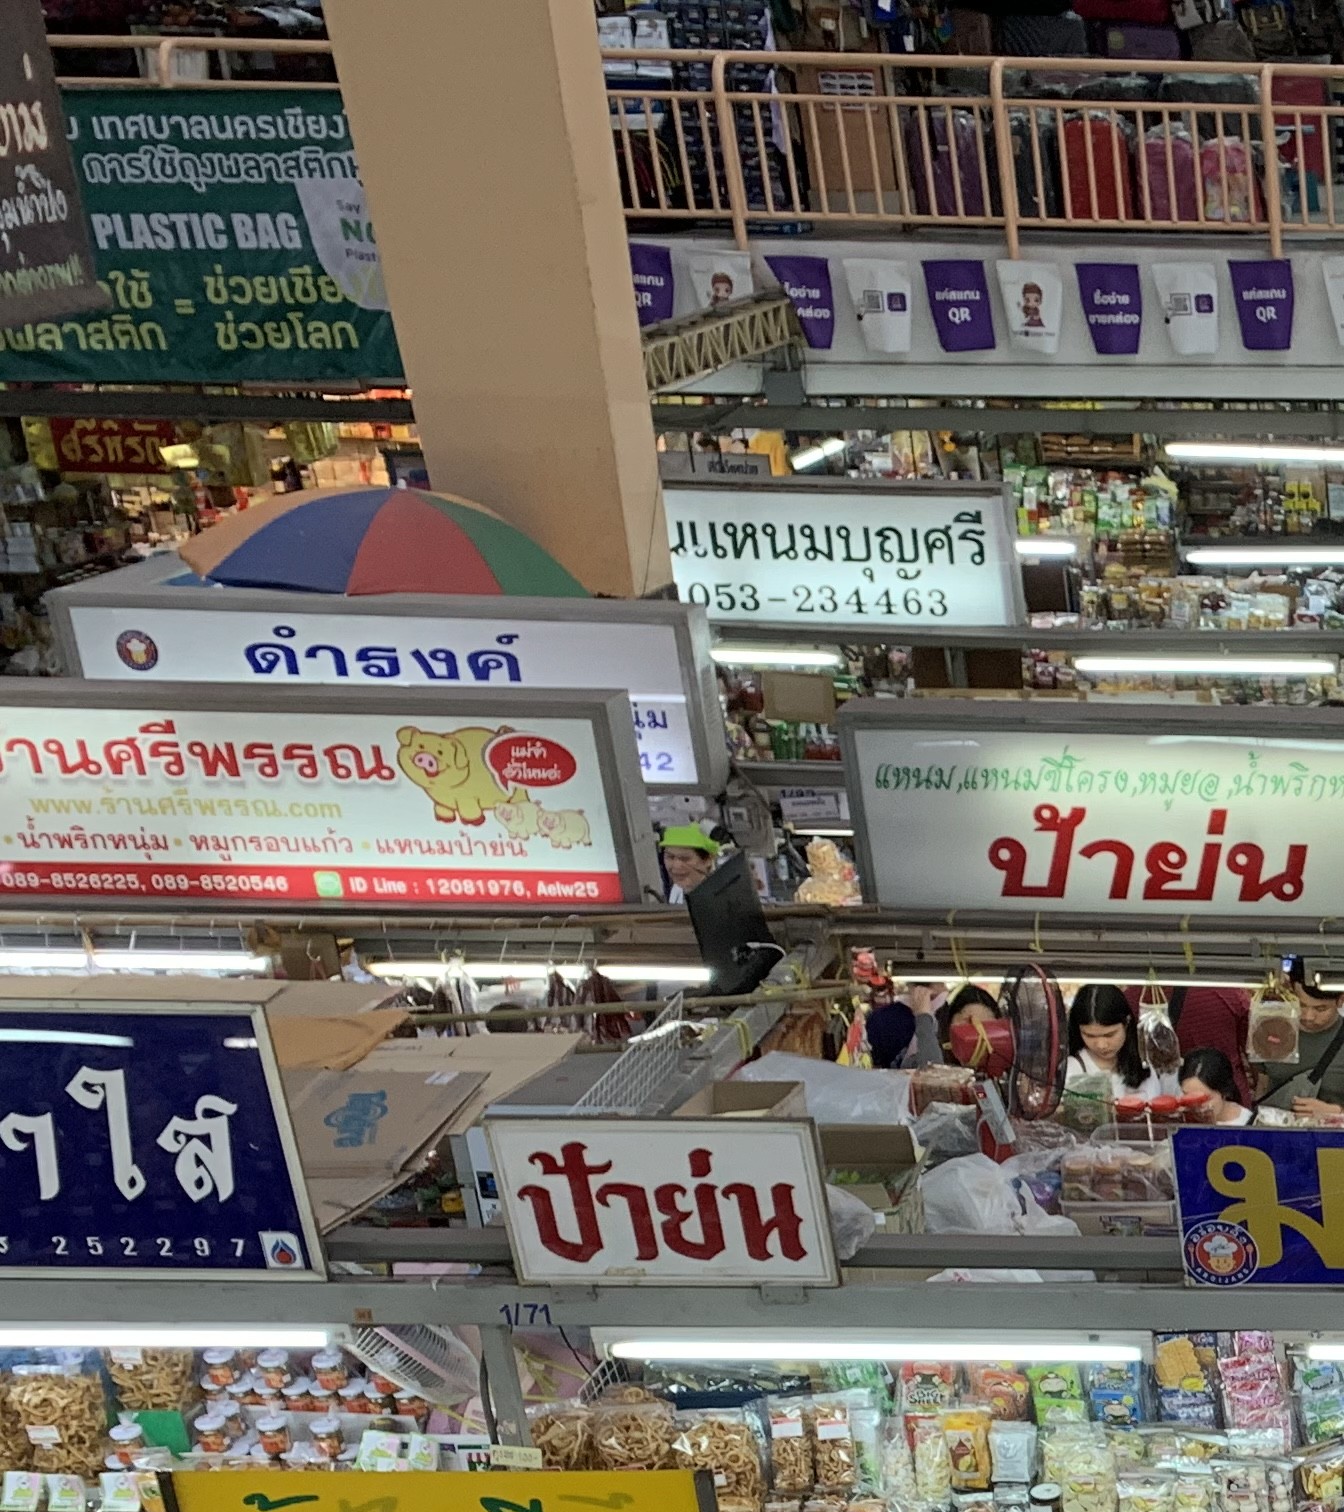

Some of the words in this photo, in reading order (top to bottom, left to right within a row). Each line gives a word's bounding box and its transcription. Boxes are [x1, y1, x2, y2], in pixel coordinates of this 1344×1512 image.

[93, 108, 348, 140] เทศบาลนครเชียง
[92, 213, 227, 250] PLASTIC
[232, 213, 301, 250] BAG
[215, 311, 359, 351] ช่วยโลก
[948, 307, 971, 324] QR
[1255, 305, 1278, 322] QR
[687, 583, 949, 618] 053-234463
[243, 626, 523, 684] ดำรงค์
[0, 719, 398, 784] านศรีพรรณ
[17, 815, 170, 861] น้ำพริกหนุ่ม
[189, 827, 355, 862] หมูกรอบแก้ว
[376, 830, 528, 859] แหนมป้าย่น
[988, 803, 1308, 904] ป้าย่น
[349, 877, 368, 893] ID
[374, 877, 408, 894] Line
[517, 1140, 809, 1264] ป้าย่น
[500, 1302, 553, 1328] 1/71
